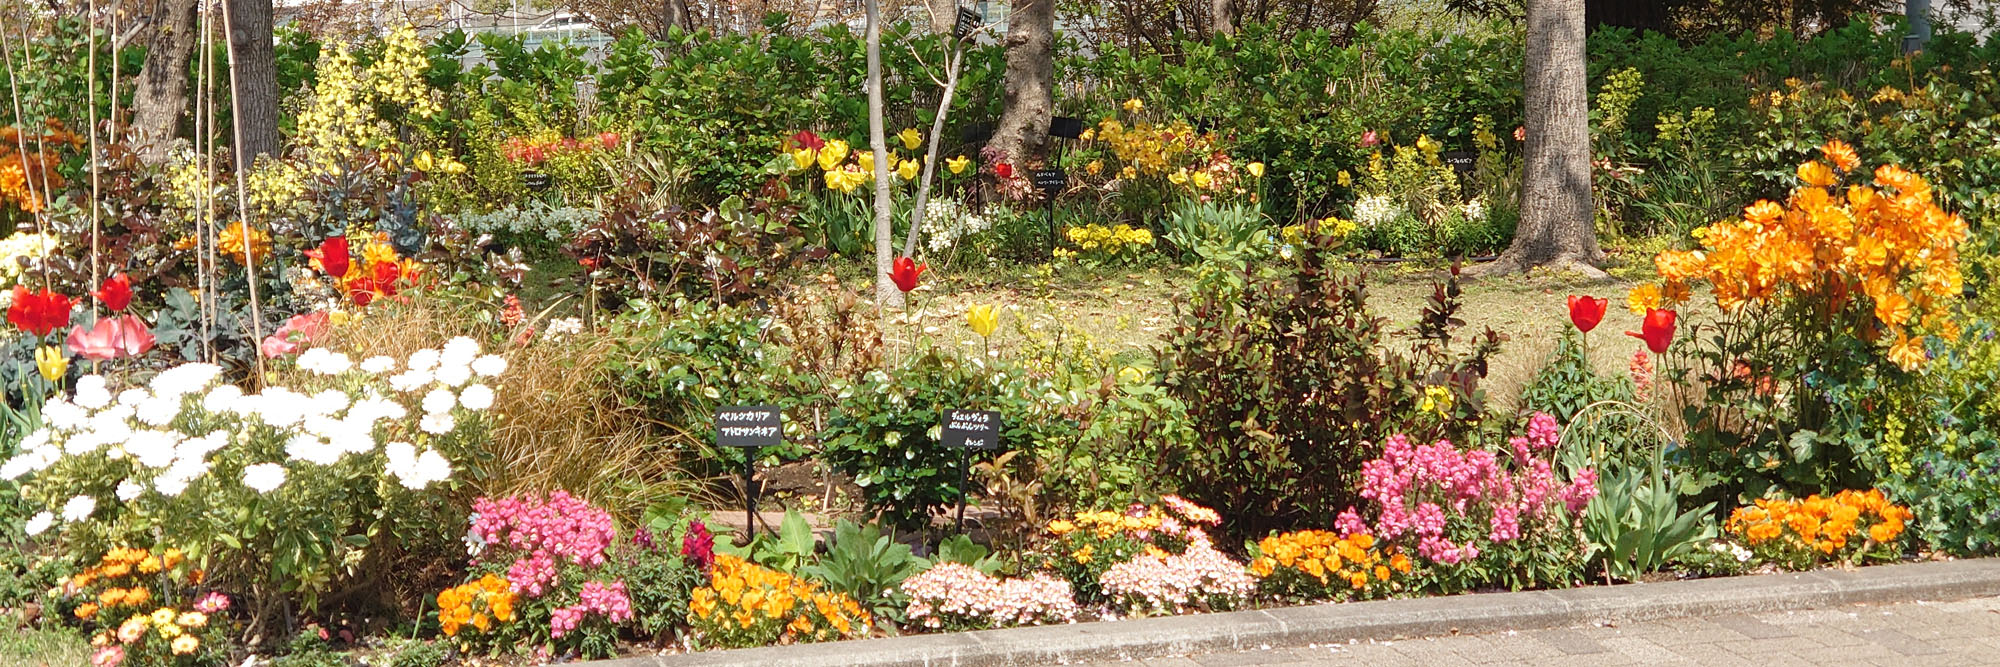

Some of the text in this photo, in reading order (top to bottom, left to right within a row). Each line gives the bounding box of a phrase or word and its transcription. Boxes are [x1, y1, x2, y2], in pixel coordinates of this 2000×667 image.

[719, 411, 770, 421] ペルシカリア
